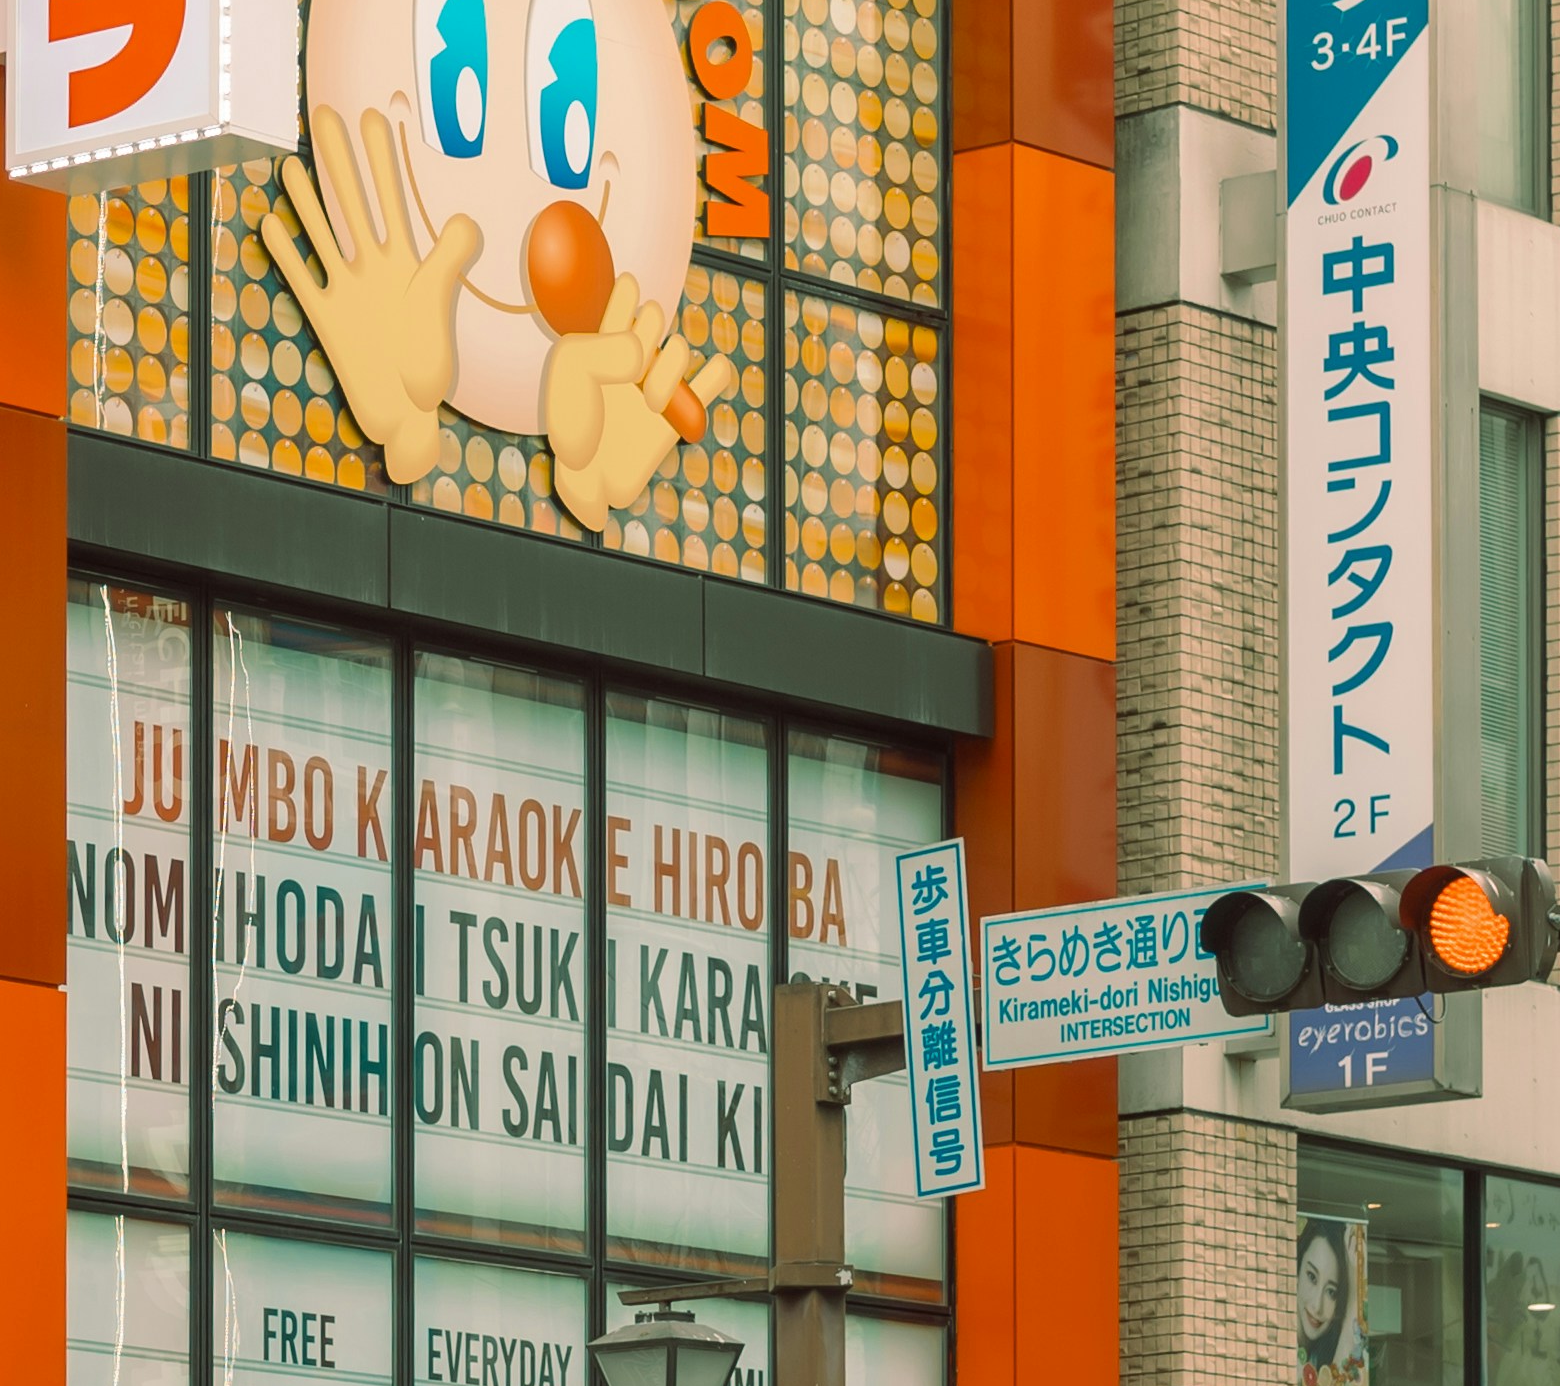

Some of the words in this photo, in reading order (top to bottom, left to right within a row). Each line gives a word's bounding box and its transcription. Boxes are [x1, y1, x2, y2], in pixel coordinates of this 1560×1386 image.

[1316, 211, 1347, 226] CHUO
[1350, 201, 1398, 220] CONTACT
[1322, 235, 1396, 776] 中央コンタクト
[121, 720, 335, 853] JUMBO
[356, 760, 632, 909] KARAOKE
[653, 826, 848, 950] HIROBA
[1332, 793, 1391, 839] 2F
[66, 838, 426, 985] NOMIHODAI
[448, 907, 618, 1020] TSUKI
[640, 936, 879, 1054] KARA
[910, 861, 968, 1177] 歩車分離信号
[998, 976, 1140, 1025] Kirameki-dori
[1060, 1009, 1191, 1044] INTERSECTION
[1297, 1010, 1429, 1049] eyerobics
[129, 981, 480, 1128] NISHINIHON
[501, 1044, 689, 1163] SAIDAI
[1337, 1051, 1389, 1089] 1F
[262, 1307, 337, 1370] FREE
